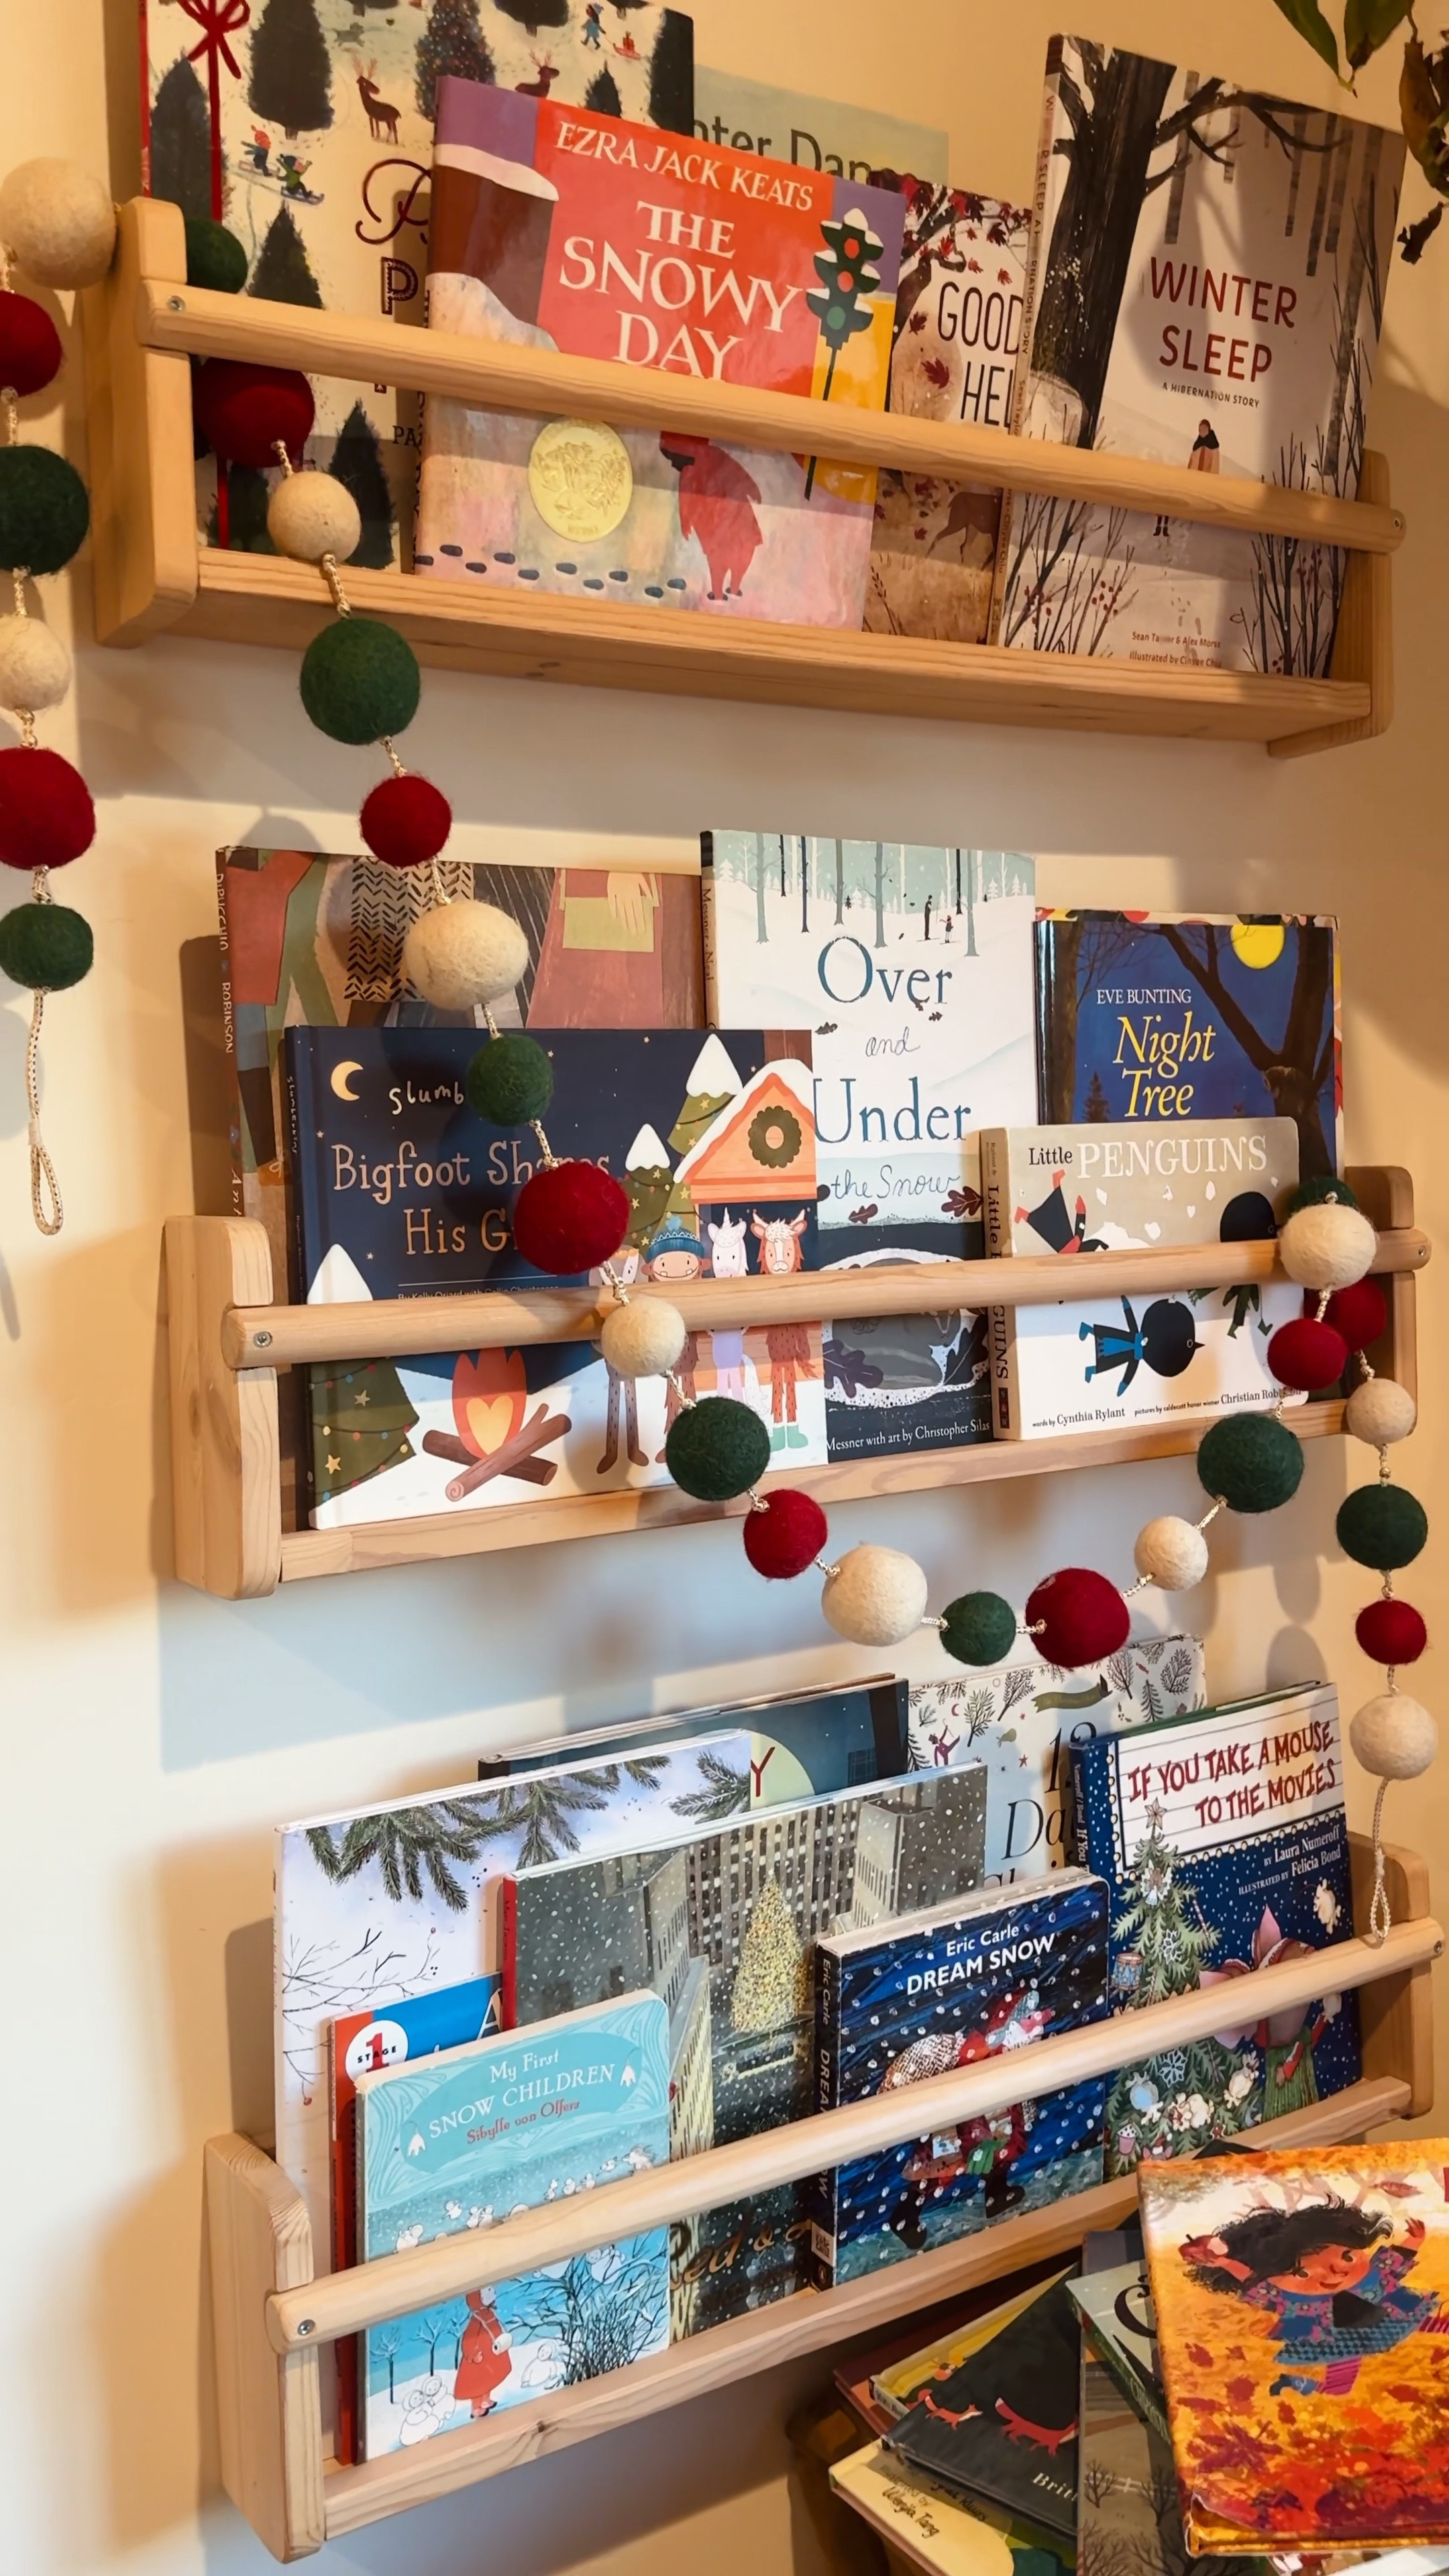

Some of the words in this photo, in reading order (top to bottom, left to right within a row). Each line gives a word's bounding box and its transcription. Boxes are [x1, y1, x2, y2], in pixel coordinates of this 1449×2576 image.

[555, 121, 639, 169] EZRA
[644, 146, 723, 190] JACK
[730, 166, 813, 211] KEATS
[1036, 164, 1049, 211] SLEEP
[636, 201, 735, 260] THE
[559, 237, 803, 333] SNOWY
[1150, 257, 1297, 328] WINTER
[612, 310, 744, 381] DAY
[1021, 317, 1032, 355] SORY
[1159, 325, 1272, 382] SLEEP
[1163, 382, 1168, 390] A
[1171, 383, 1230, 402] HIBERNATION
[1233, 394, 1260, 408] STORY
[1130, 651, 1168, 663] Illustrated
[1132, 631, 1149, 641] Sean
[1176, 636, 1181, 645] &
[702, 888, 712, 941] Messner
[704, 951, 714, 981] Neal
[818, 936, 952, 1006] Over
[221, 982, 233, 1053] ROBINSON
[1097, 989, 1123, 1004] EVE
[1127, 989, 1191, 1004] BUNTING
[865, 1026, 920, 1057] and
[1112, 1011, 1216, 1079] Night
[813, 1077, 971, 1143] Under
[1122, 1067, 1194, 1117] Tree
[331, 1140, 470, 1205] Bigfoot
[1028, 1146, 1073, 1165] Little
[1077, 1135, 1268, 1179] PENGUINS
[831, 1169, 872, 1199] the
[877, 1165, 960, 1199] Snow
[404, 1208, 465, 1255] His
[987, 1185, 1001, 1244] Little
[1057, 1411, 1093, 1426] Cynthia
[1095, 1409, 1125, 1423] Rylant
[1221, 1390, 1260, 1405] Christian
[826, 1437, 863, 1450] Messner
[865, 1430, 886, 1446] with
[888, 1434, 900, 1444] art
[902, 1428, 913, 1445] by
[915, 1421, 969, 1440] Christopher
[970, 1419, 990, 1432] Silas
[751, 1747, 775, 1797] Y
[1128, 1762, 1151, 1802] IF
[1157, 1752, 1199, 1795] YOU
[1204, 1743, 1254, 1782] TAKE
[1258, 1737, 1271, 1770] A
[1275, 1720, 1334, 1766] MOUSE
[1195, 1796, 1222, 1828] TO
[1226, 1783, 1265, 1819] THE
[1268, 1758, 1335, 1809] MOVIES
[1238, 1874, 1281, 1895] ILLUSTRATED
[1281, 1871, 1289, 1880] BY
[1291, 1858, 1319, 1877] Felicia
[1321, 1845, 1341, 1866] Bond
[1264, 1857, 1272, 1867] BY
[1275, 1847, 1299, 1864] Laura
[1301, 1825, 1340, 1853] Numeroff
[908, 1955, 983, 1996] DREAM
[989, 1933, 1055, 1970] SNOW
[947, 1937, 975, 1957] Eric
[980, 1925, 1019, 1945] Carle
[822, 1958, 831, 1983] Eric
[822, 1988, 831, 2025] Carle
[357, 2045, 397, 2063] STAGE
[490, 2063, 517, 2084] My
[523, 2048, 559, 2072] First
[429, 2095, 496, 2139] SNOW
[502, 2063, 615, 2107] CHILDREN
